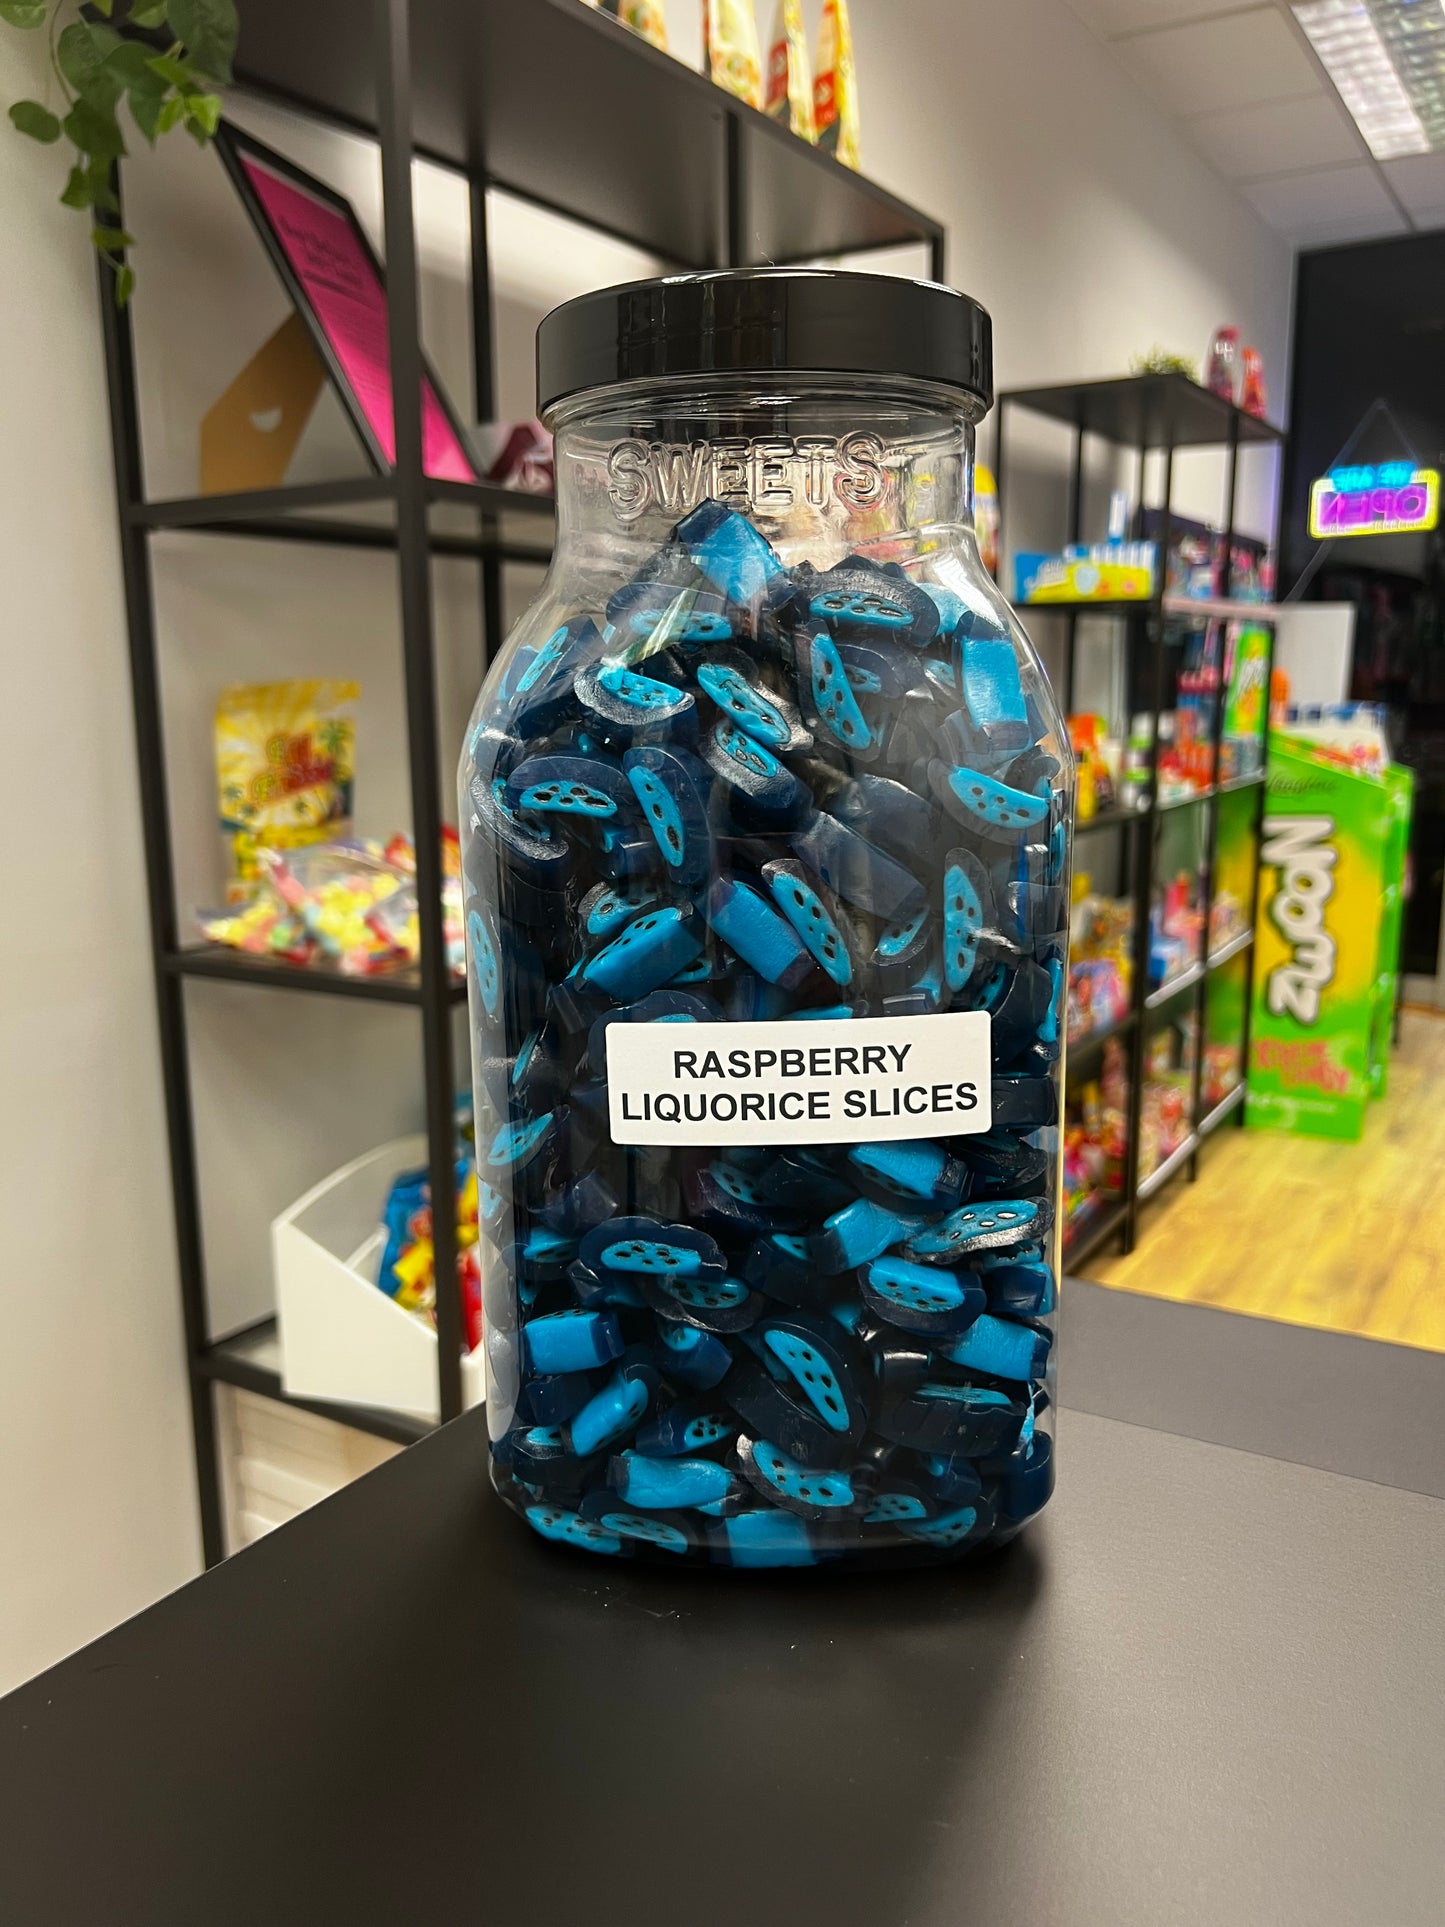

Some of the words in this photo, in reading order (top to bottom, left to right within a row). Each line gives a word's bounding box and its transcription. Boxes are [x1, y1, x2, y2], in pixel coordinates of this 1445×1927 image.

[606, 430, 889, 521] SWEETS
[674, 1044, 912, 1079] RASPBERRY
[621, 1091, 830, 1123] LIQUORICE
[844, 1082, 979, 1118] SLICES
